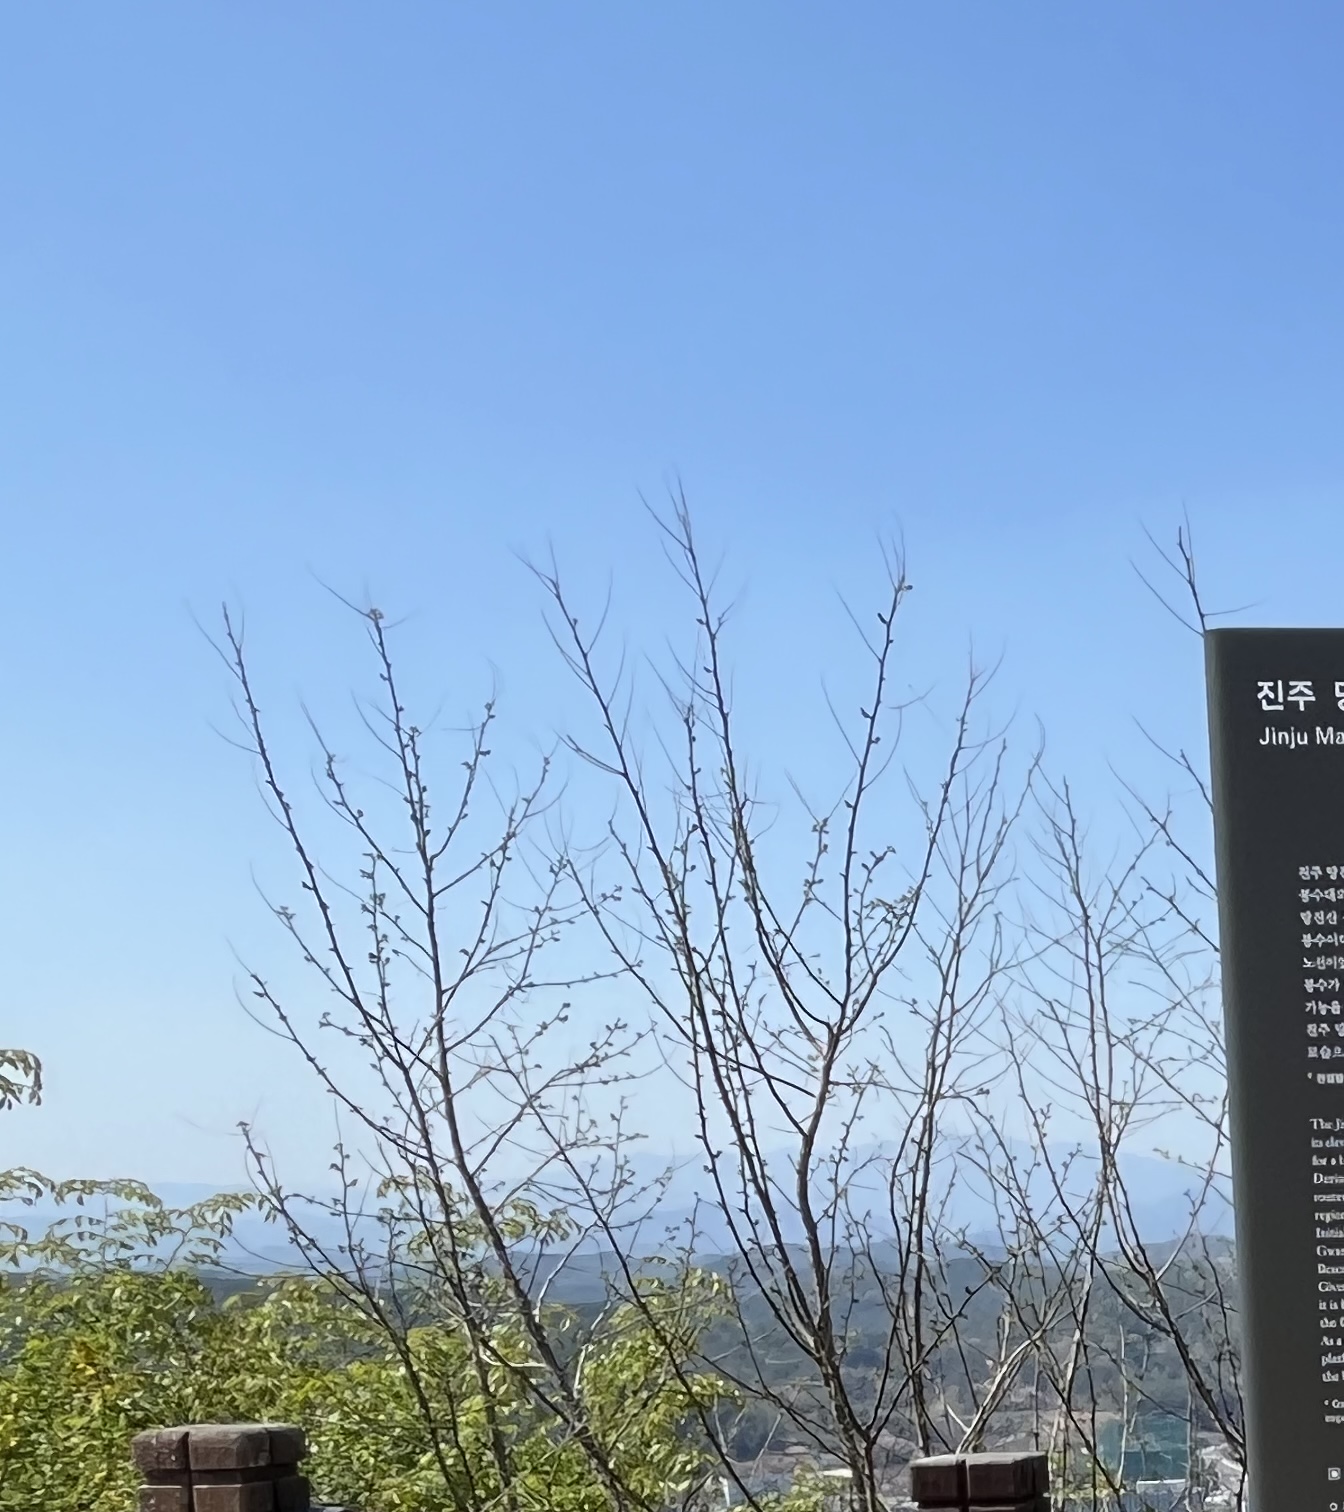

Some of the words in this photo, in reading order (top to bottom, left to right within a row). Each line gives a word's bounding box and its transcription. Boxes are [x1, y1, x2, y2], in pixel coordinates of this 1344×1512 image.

[1256, 679, 1316, 711] 진주
[1258, 726, 1308, 748] Jinju
[1309, 1117, 1332, 1130] The
